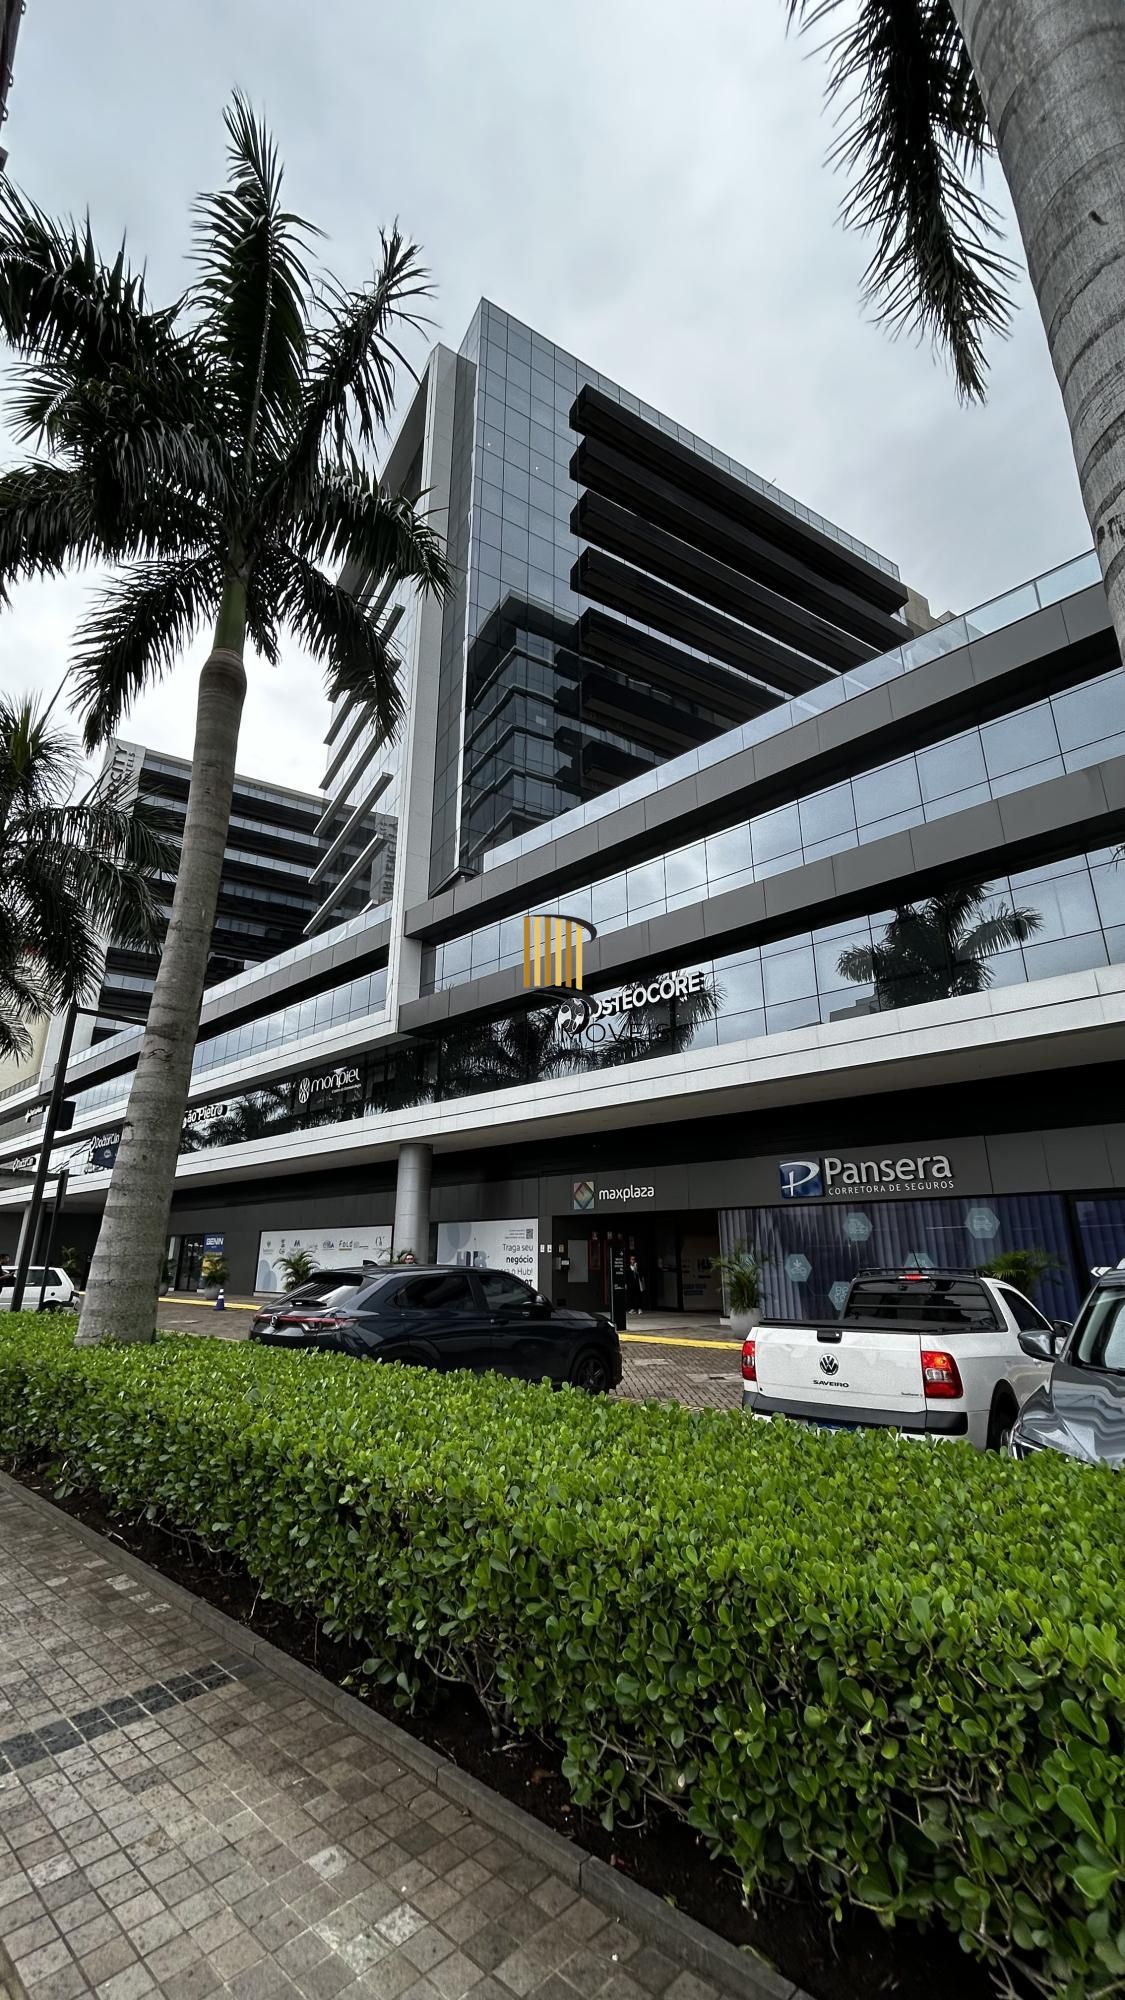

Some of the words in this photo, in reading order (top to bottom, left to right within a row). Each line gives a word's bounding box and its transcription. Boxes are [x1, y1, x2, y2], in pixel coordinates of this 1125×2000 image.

[198, 1105, 223, 1120] Pietro
[824, 1155, 953, 1185] Pansera
[599, 1185, 655, 1202] maxplaza
[828, 1186, 886, 1196] CORRETORA
[889, 1183, 902, 1193] DE
[904, 1180, 955, 1191] SEGUROS
[502, 1243, 520, 1253] Traga
[506, 1255, 533, 1265] negócio
[813, 1379, 850, 1388] SAVEIRO
